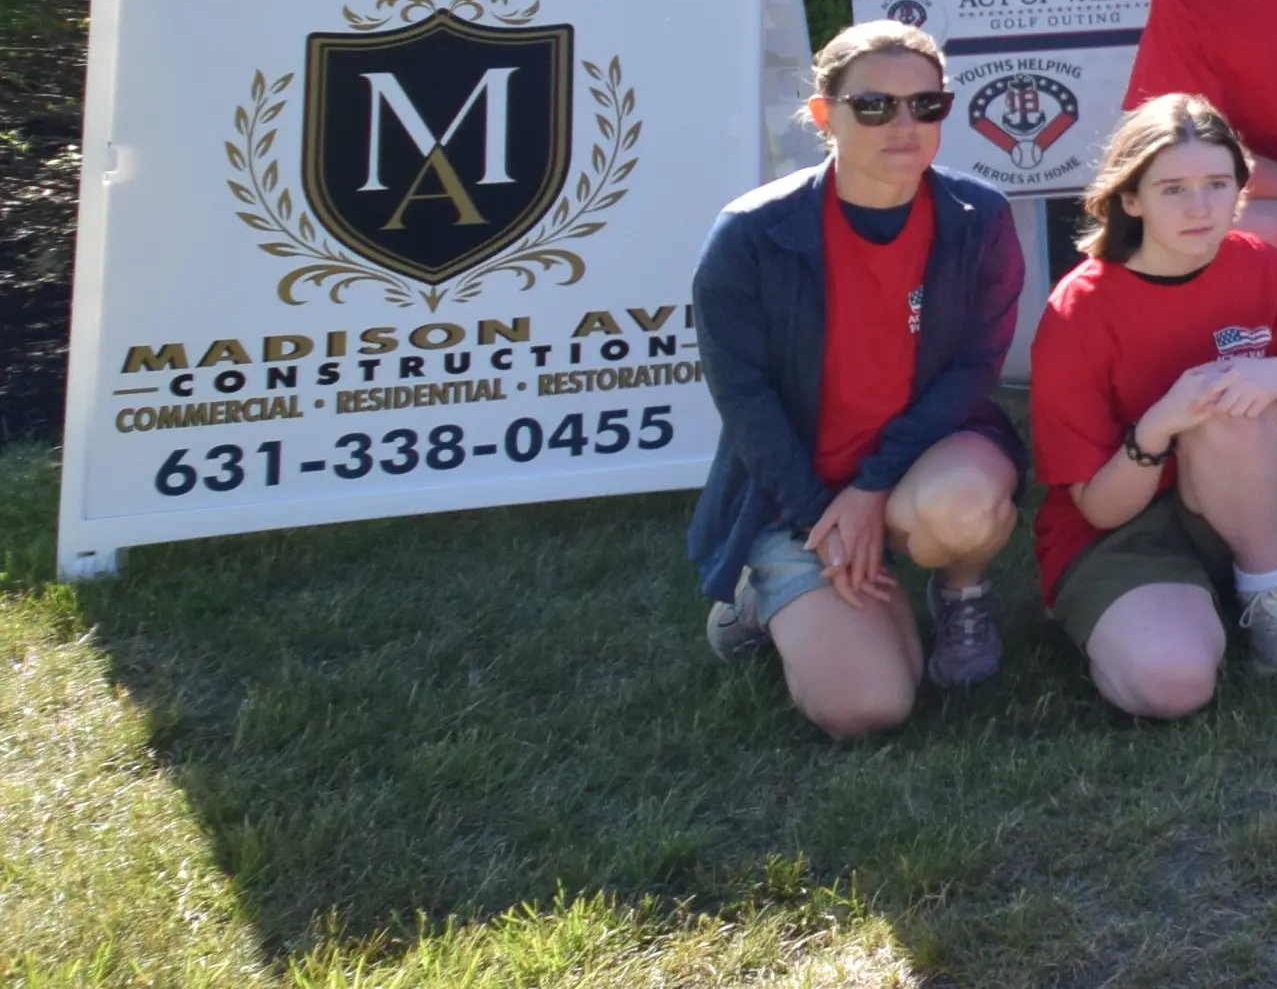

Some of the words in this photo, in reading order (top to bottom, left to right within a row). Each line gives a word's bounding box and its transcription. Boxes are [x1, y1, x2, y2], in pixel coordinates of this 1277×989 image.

[989, 17, 1038, 30] GOLF
[1047, 12, 1122, 27] OUTING
[954, 59, 1014, 86] YOUTHS
[1016, 57, 1083, 80] HELPING
[972, 161, 1025, 185] HEROES
[1026, 171, 1041, 184] AT
[1043, 155, 1082, 181] HOME
[120, 316, 531, 374] MADISON
[170, 335, 677, 397] CONSTRUCTION
[115, 394, 304, 434] COMMERCIAL
[336, 377, 508, 415] RESIDENTIAL
[154, 405, 675, 497] 631-338-0455
